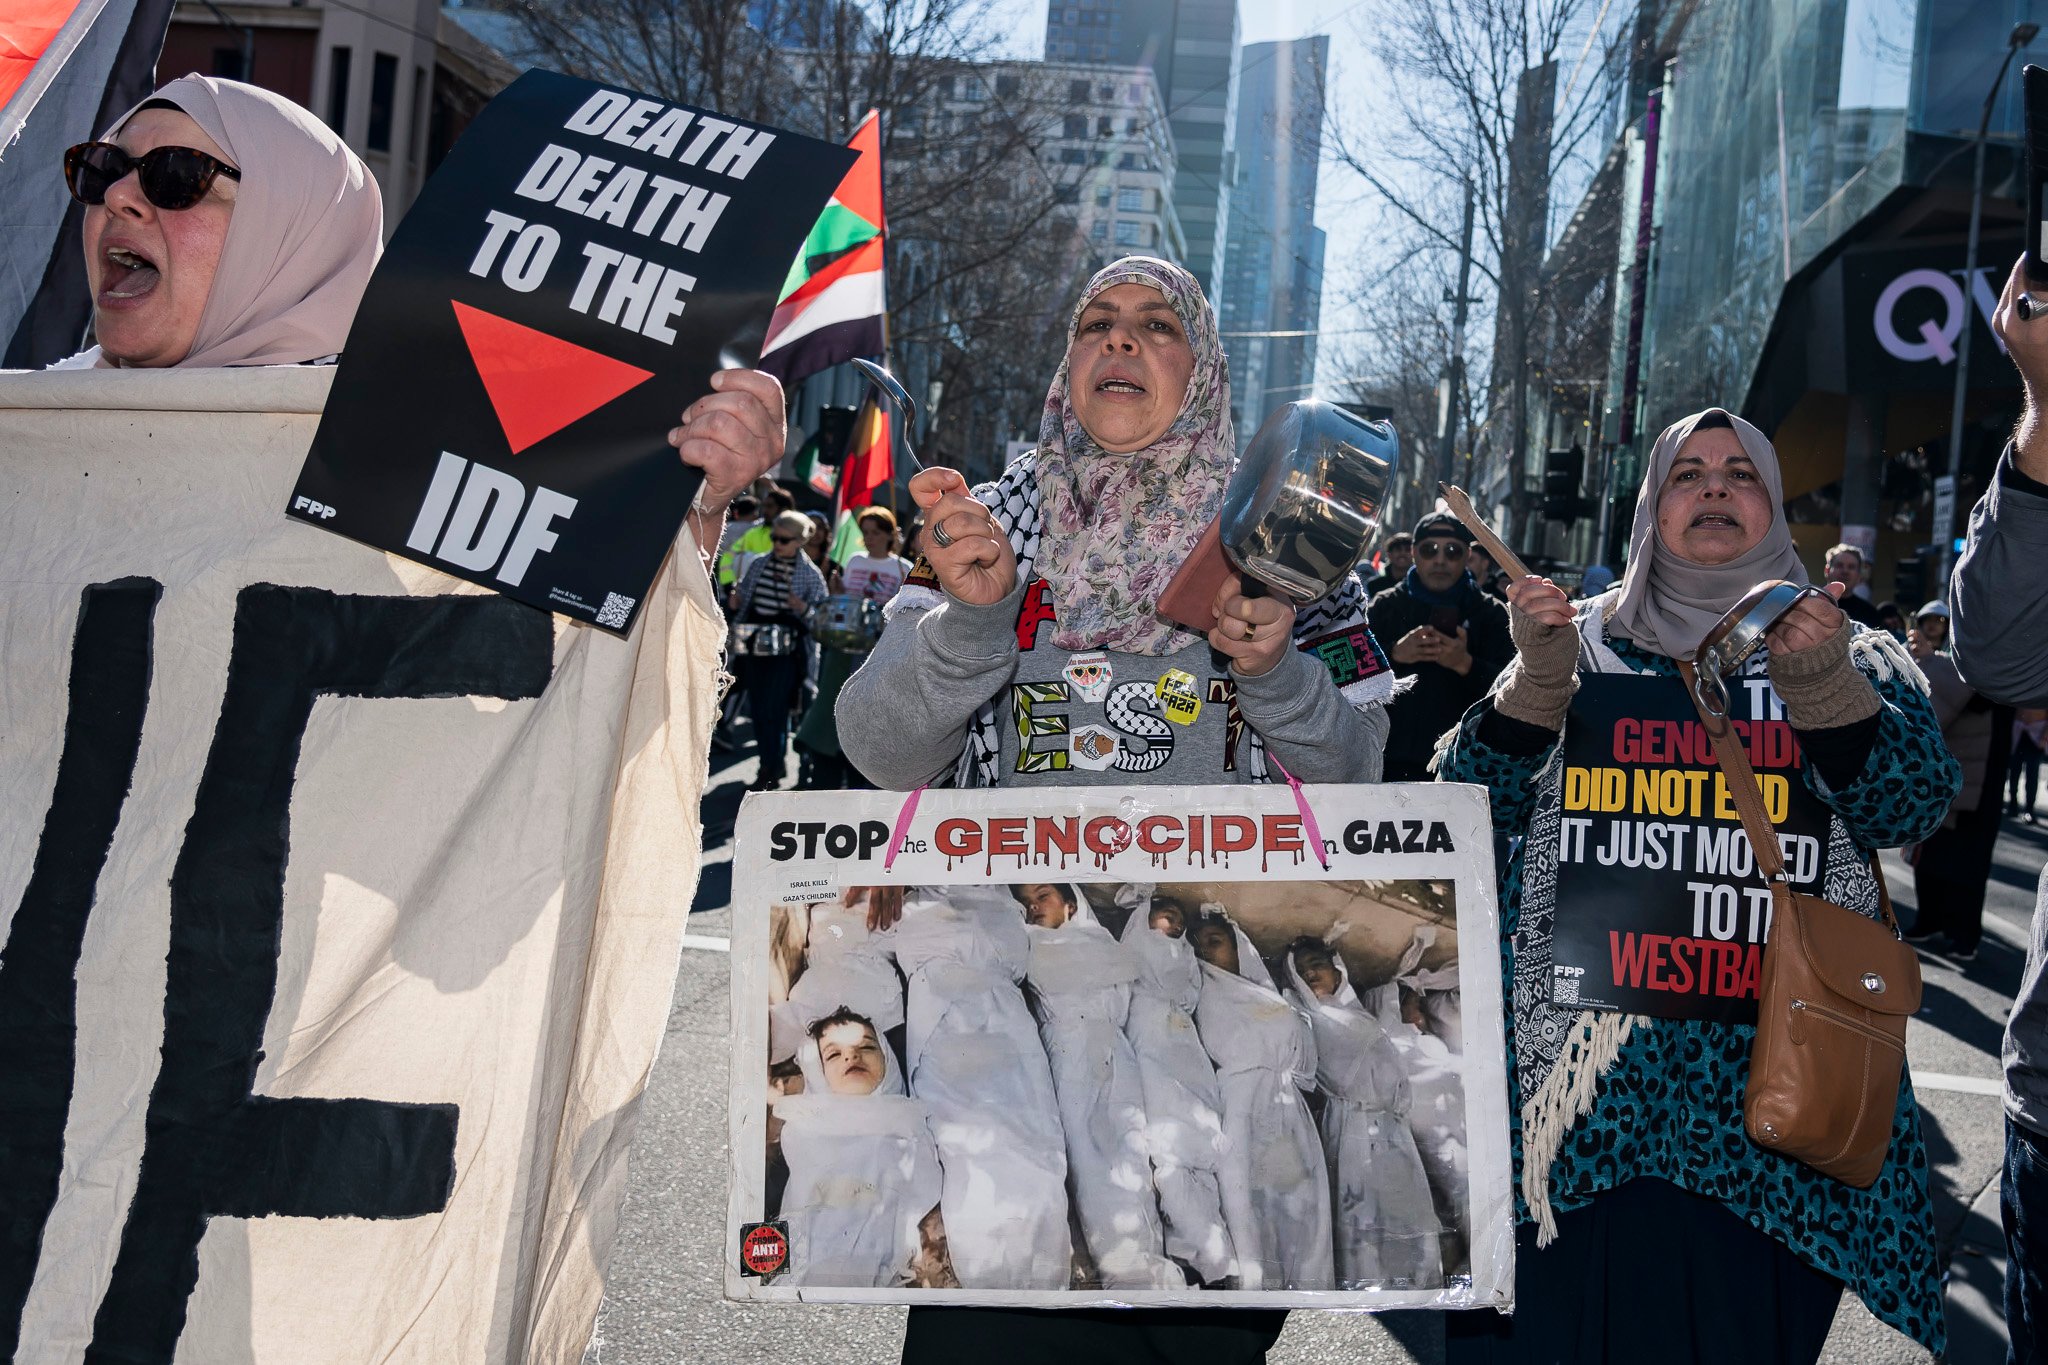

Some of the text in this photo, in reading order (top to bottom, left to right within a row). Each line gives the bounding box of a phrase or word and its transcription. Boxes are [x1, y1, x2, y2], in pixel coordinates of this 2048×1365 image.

[564, 89, 777, 181] DEATH
[514, 143, 732, 254] DEATH
[468, 209, 698, 346] TO THE
[294, 495, 337, 519] FPP
[406, 450, 578, 587] IDF
[1612, 718, 1800, 768] GENOCID
[1564, 767, 1627, 813] DID
[1633, 768, 1708, 818] NOT
[770, 816, 1456, 872] STOP he GENOCIDE n GAZA
[1559, 817, 1819, 884] IT JUST MOED
[782, 891, 837, 903] GAZA'S CHILDREN
[812, 879, 829, 887] KILLS
[1687, 881, 1737, 941] TO
[1554, 965, 1585, 978] FPP
[752, 1236, 778, 1245] PROUD
[752, 1243, 779, 1257] ANTI
